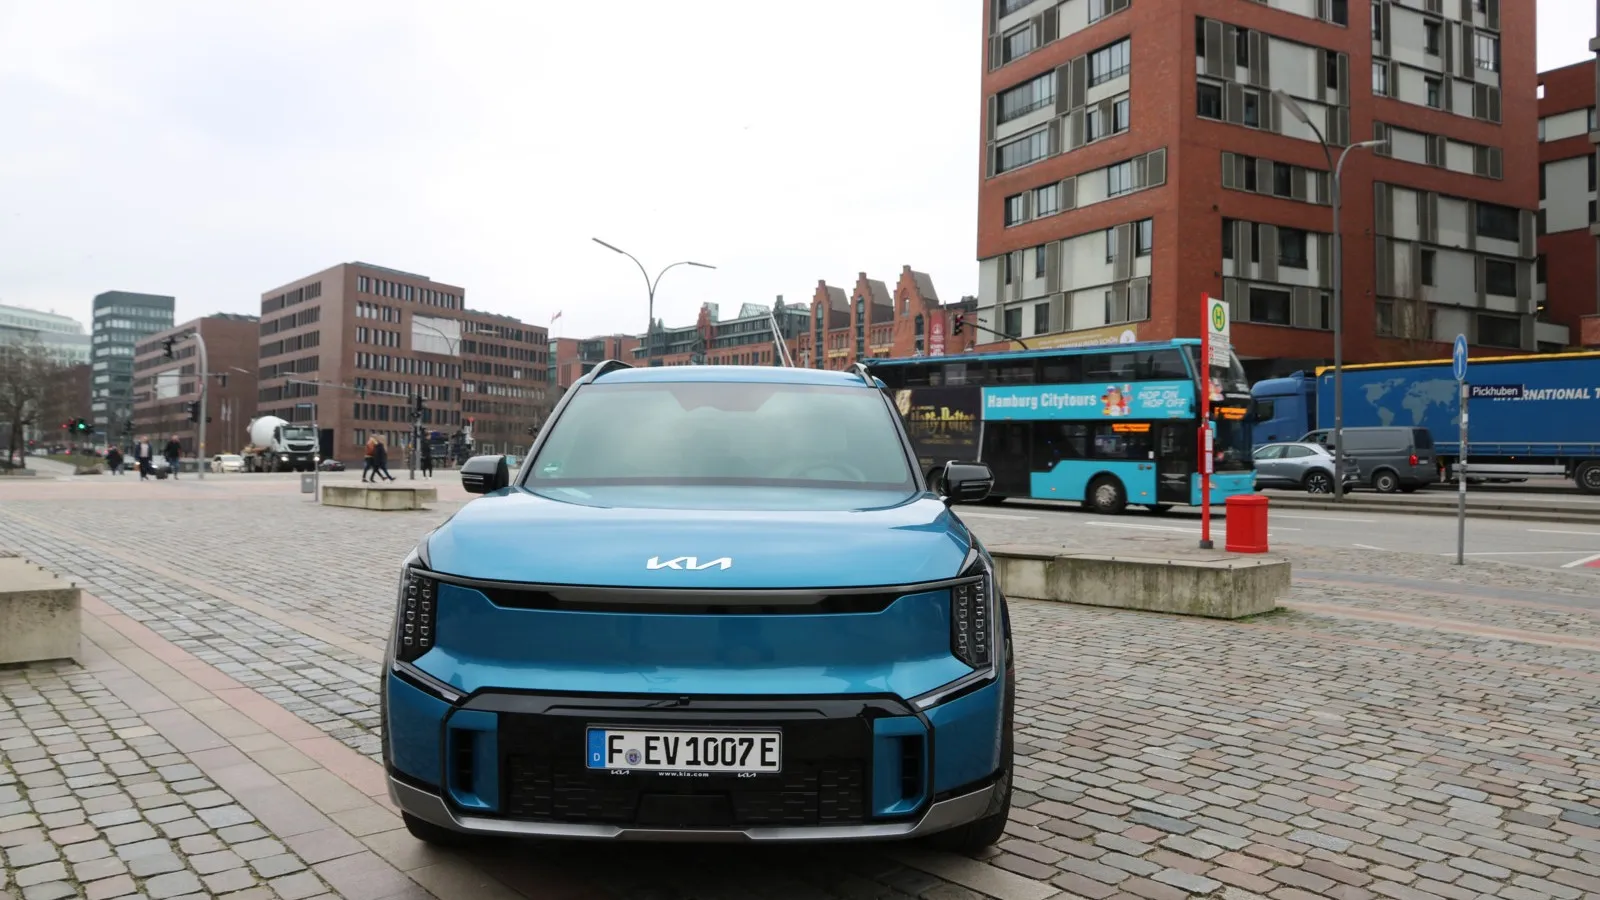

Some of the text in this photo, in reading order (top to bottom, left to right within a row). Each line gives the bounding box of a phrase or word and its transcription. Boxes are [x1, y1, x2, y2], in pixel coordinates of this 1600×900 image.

[1138, 390, 1162, 400] HOP
[1472, 386, 1518, 396] Pickhuben
[987, 393, 1097, 410] Hamburg Citytours
[608, 735, 625, 764] F
[593, 752, 601, 762] D
[658, 770, 710, 778] www.kia.com
